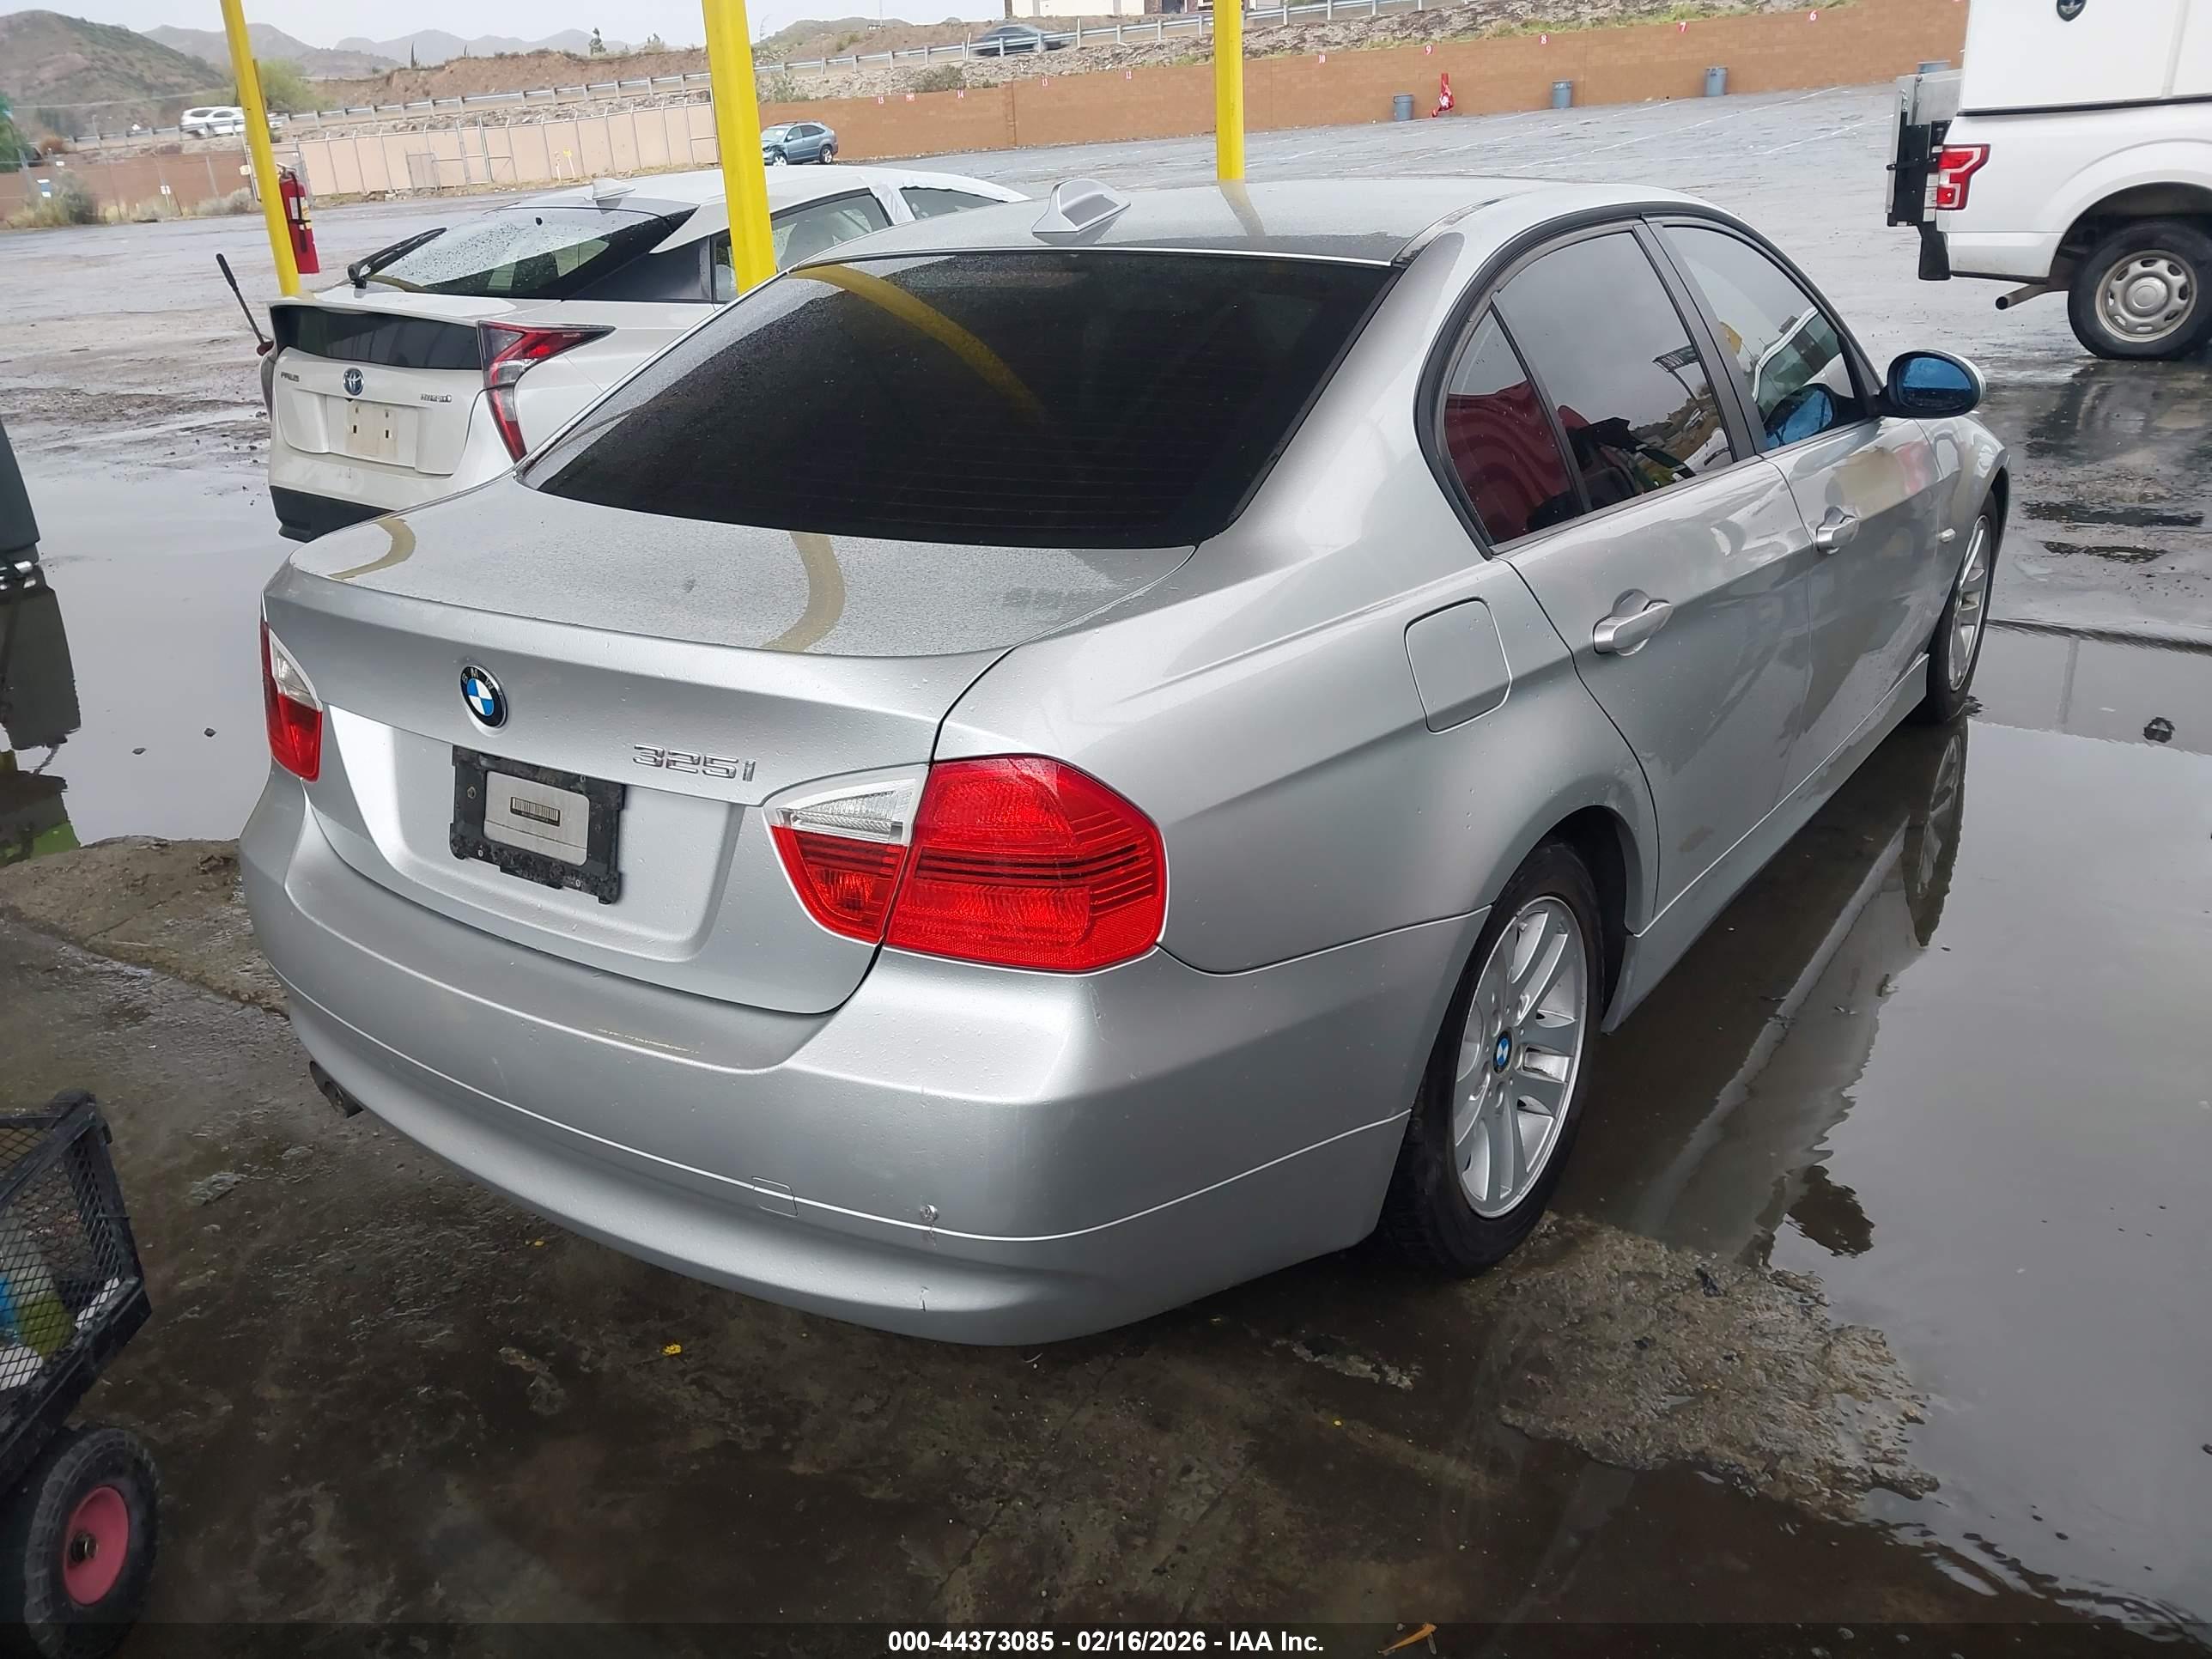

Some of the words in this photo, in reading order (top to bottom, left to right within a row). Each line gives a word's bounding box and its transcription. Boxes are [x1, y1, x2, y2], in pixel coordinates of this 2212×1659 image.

[1809, 9, 1817, 21] 6
[1680, 21, 1686, 33] 7
[1540, 34, 1547, 45] 8
[1425, 45, 1432, 56] 9
[1318, 54, 1326, 64] 10
[633, 744, 757, 782] 325i
